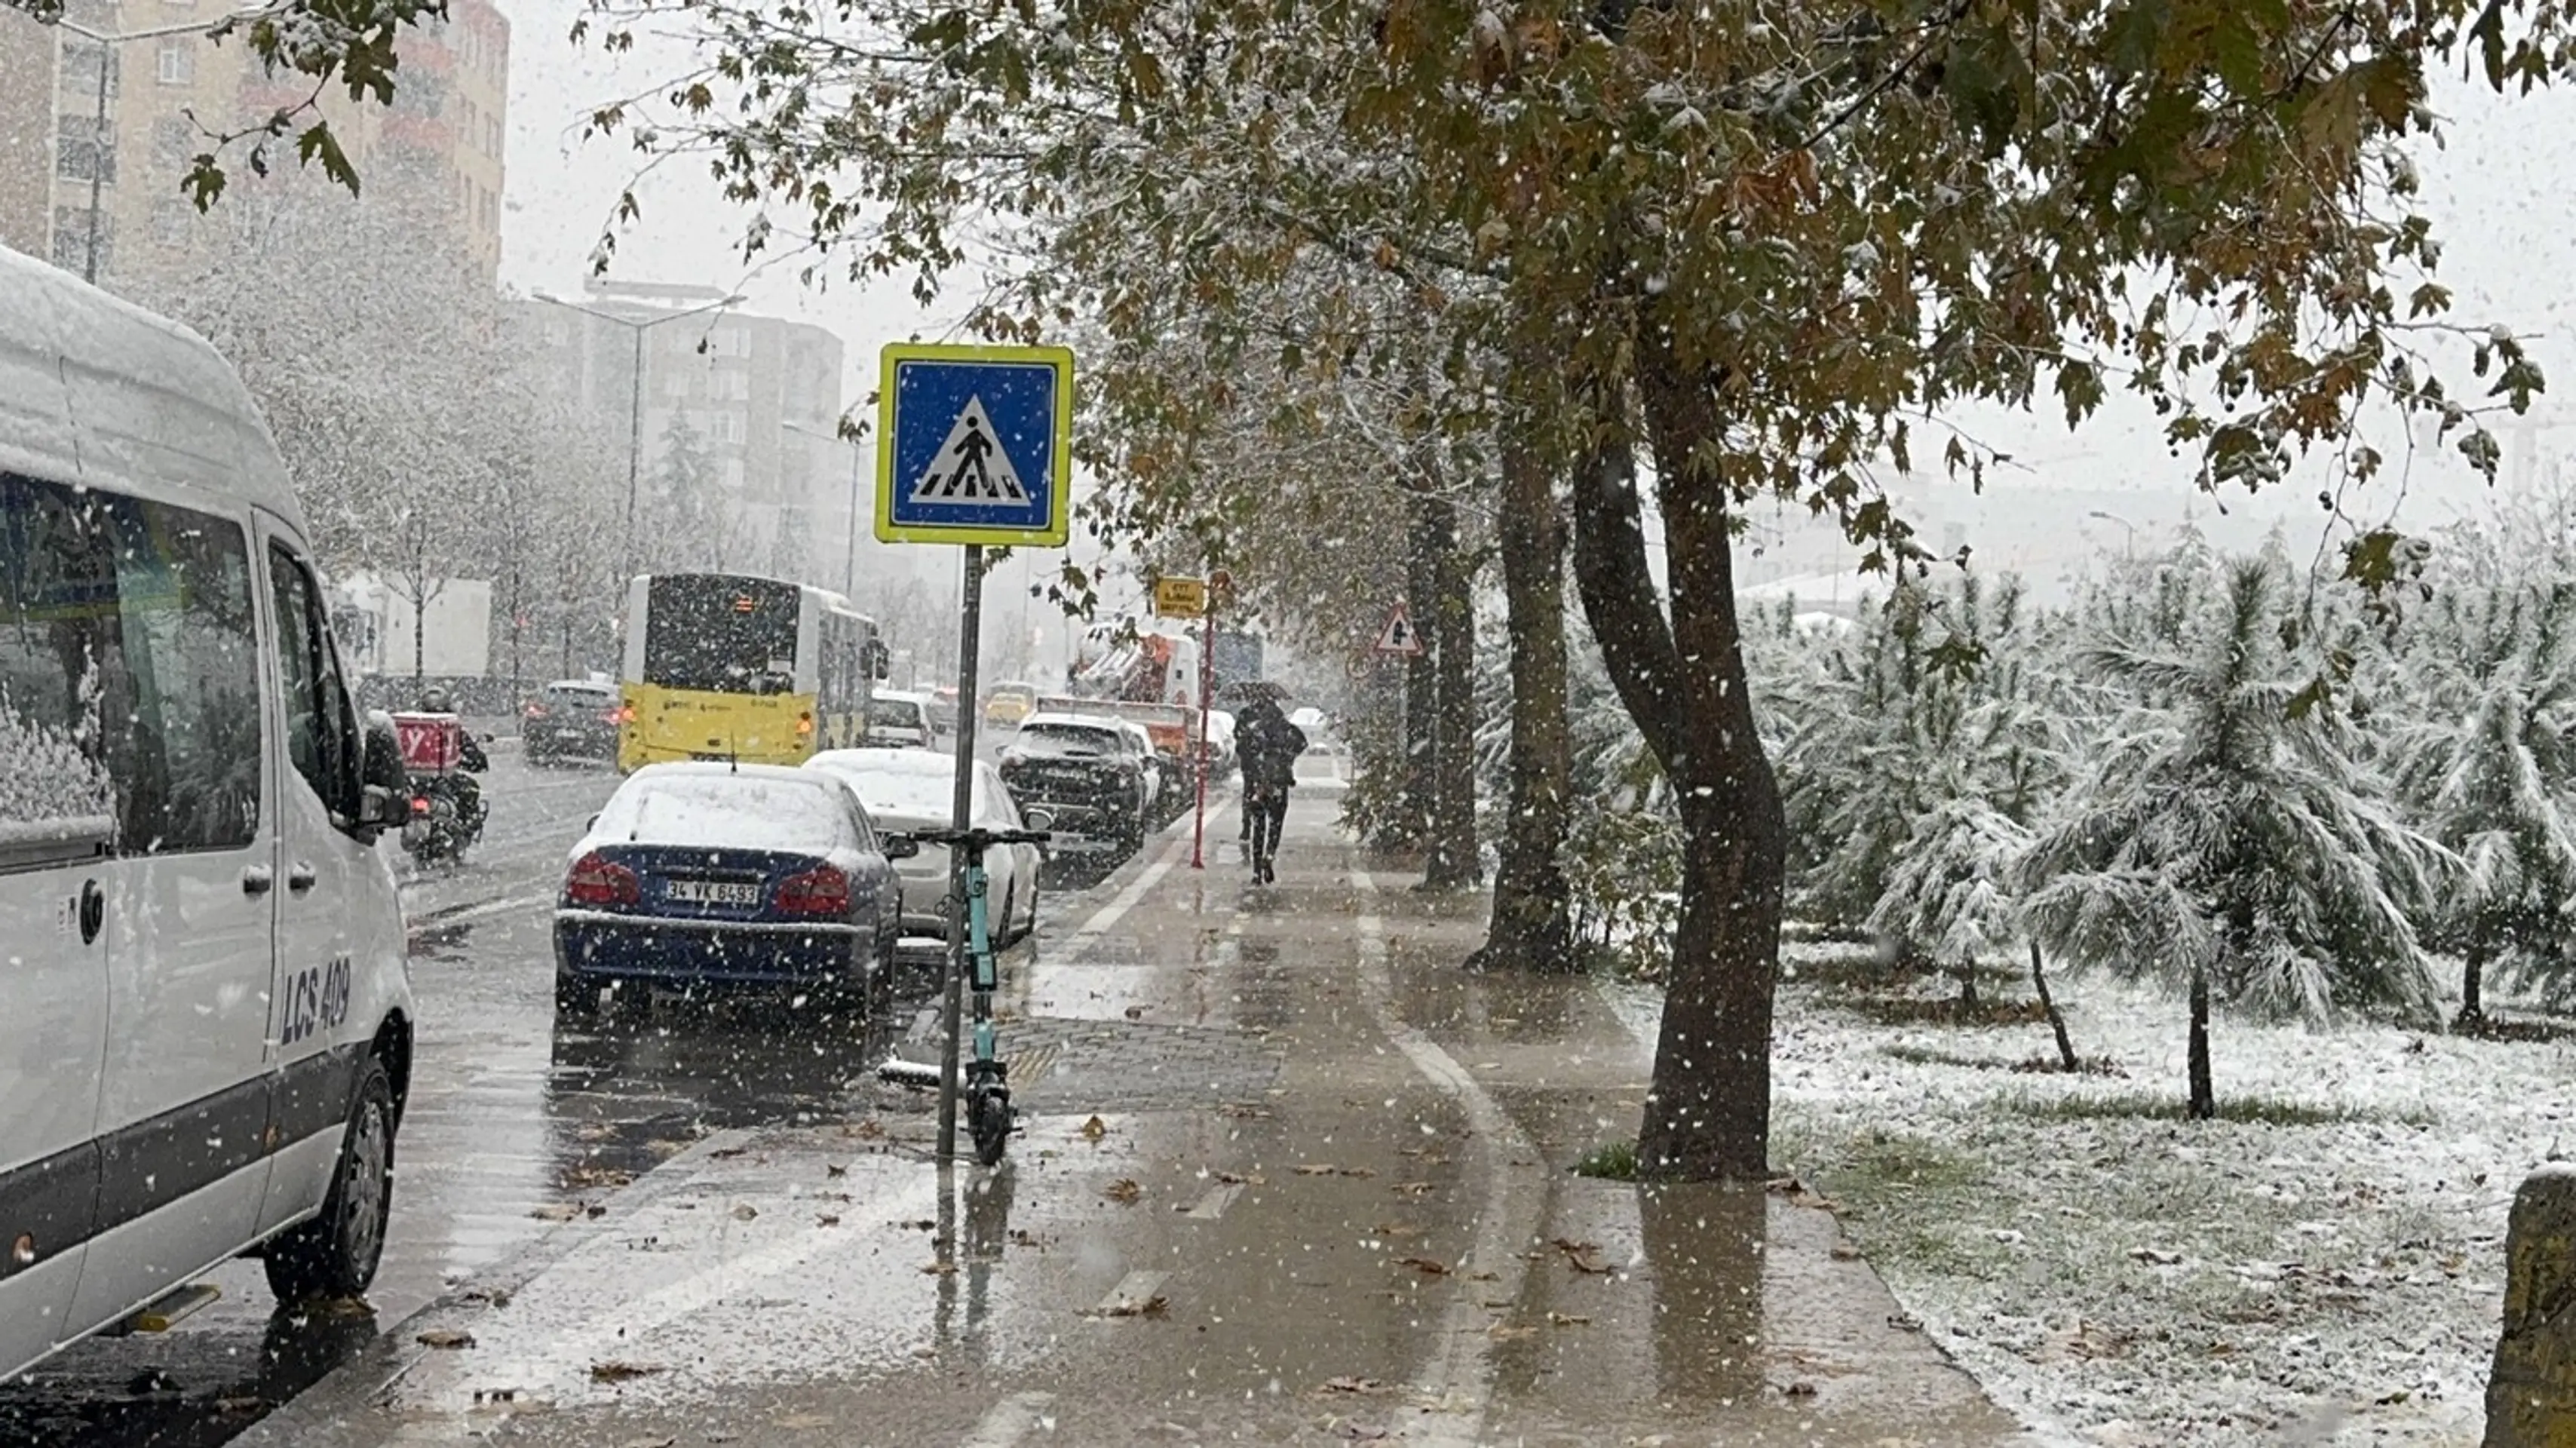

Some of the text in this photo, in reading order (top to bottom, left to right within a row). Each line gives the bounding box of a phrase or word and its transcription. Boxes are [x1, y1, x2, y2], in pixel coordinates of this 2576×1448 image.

[670, 882, 687, 898] 34
[281, 956, 351, 1046] LCS 409
